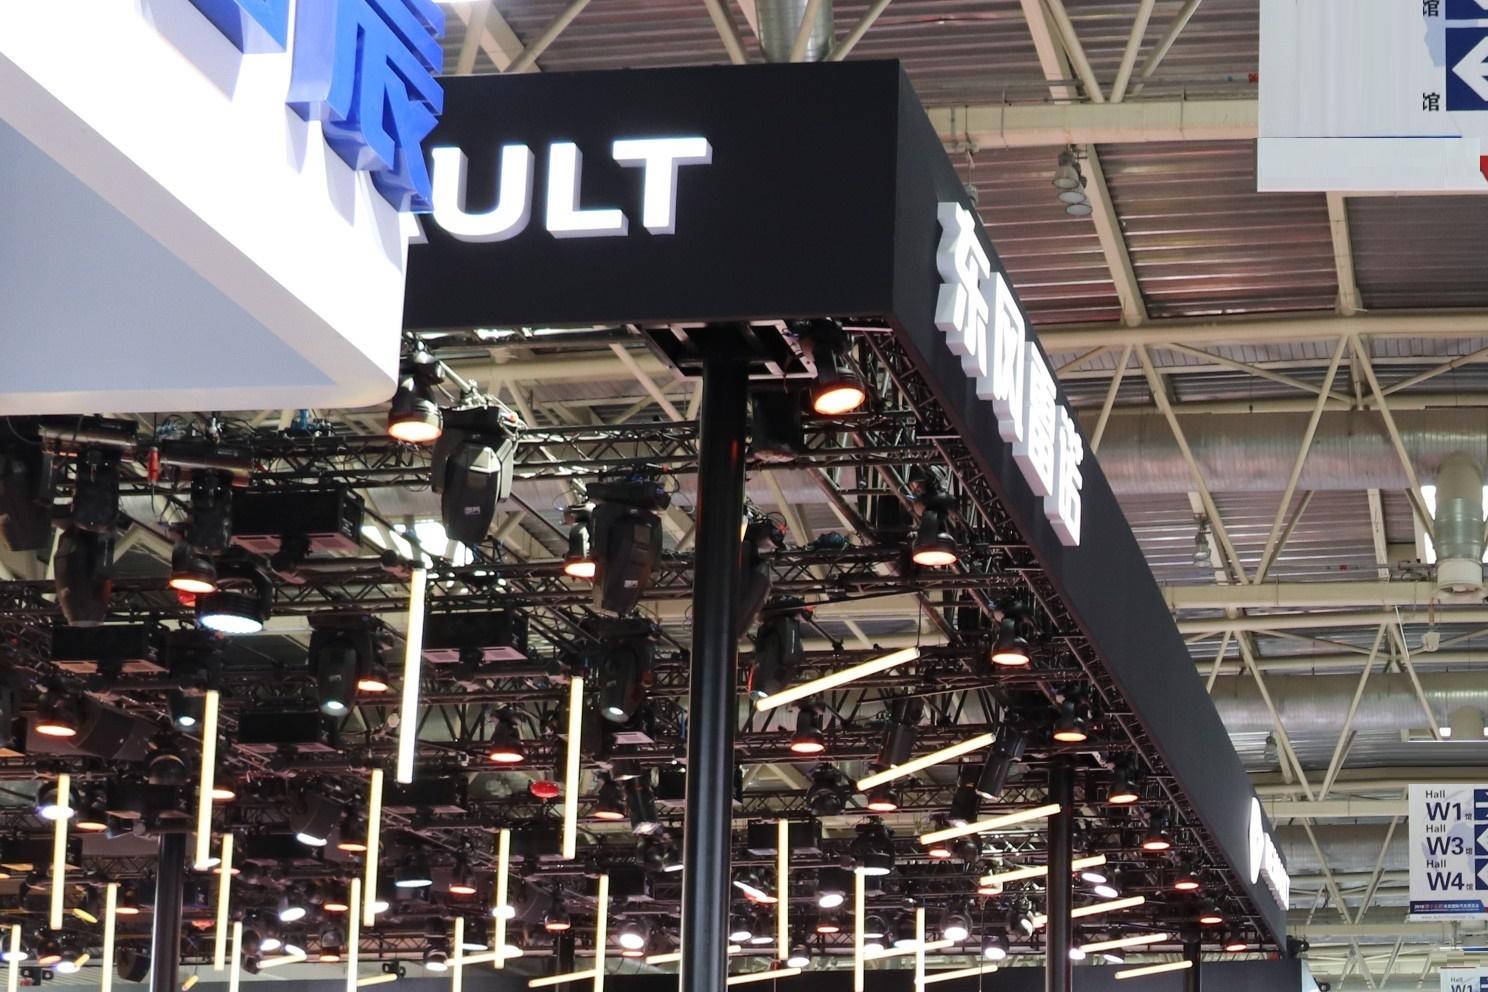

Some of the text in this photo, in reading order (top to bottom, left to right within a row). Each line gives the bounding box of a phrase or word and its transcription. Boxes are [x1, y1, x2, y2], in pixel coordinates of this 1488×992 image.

[403, 137, 712, 245] ULT
[1426, 790, 1446, 799] Hall
[1426, 802, 1461, 821] W1
[1426, 824, 1446, 833] Hall
[1427, 837, 1463, 855] W3
[1427, 859, 1447, 868] Hall
[1427, 872, 1465, 891] W4
